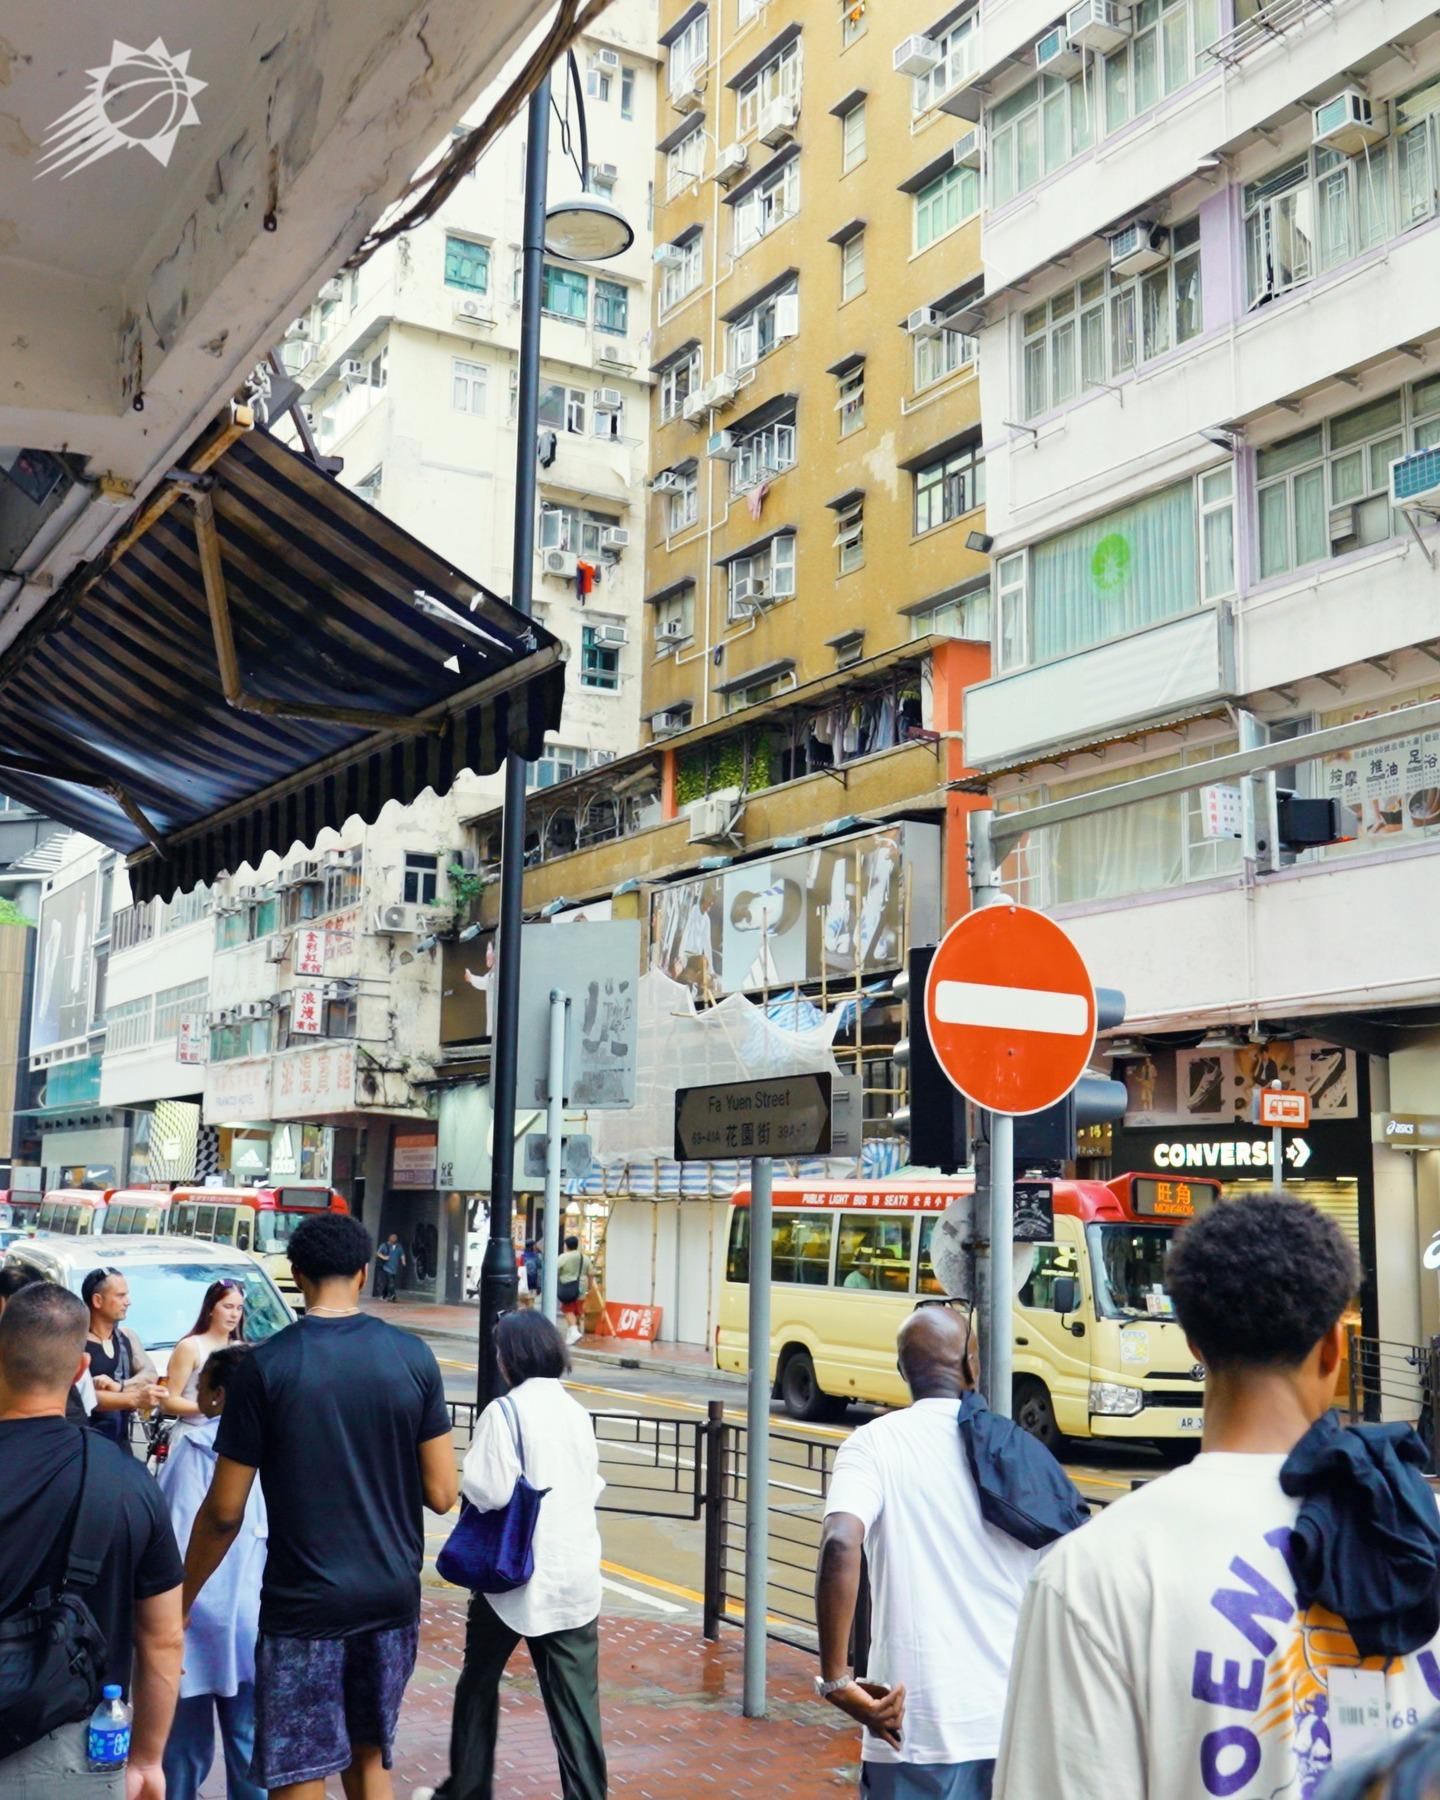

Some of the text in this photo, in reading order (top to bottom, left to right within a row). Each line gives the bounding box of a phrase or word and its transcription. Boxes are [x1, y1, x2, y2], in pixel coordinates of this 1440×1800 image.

[1330, 769, 1358, 787] 按摩
[1366, 760, 1399, 776] 推油
[301, 992, 316, 1020] 浪漫
[708, 1089, 791, 1113] Fa Yuen Street
[726, 1121, 771, 1148] 花園街
[802, 1193, 825, 1205] PUBLIC
[828, 1194, 849, 1205] LIGHT
[853, 1195, 866, 1205] BUS
[884, 1195, 908, 1206] SEATS
[1157, 1182, 1191, 1204] 旺角
[1154, 1203, 1194, 1215] MONGKOK
